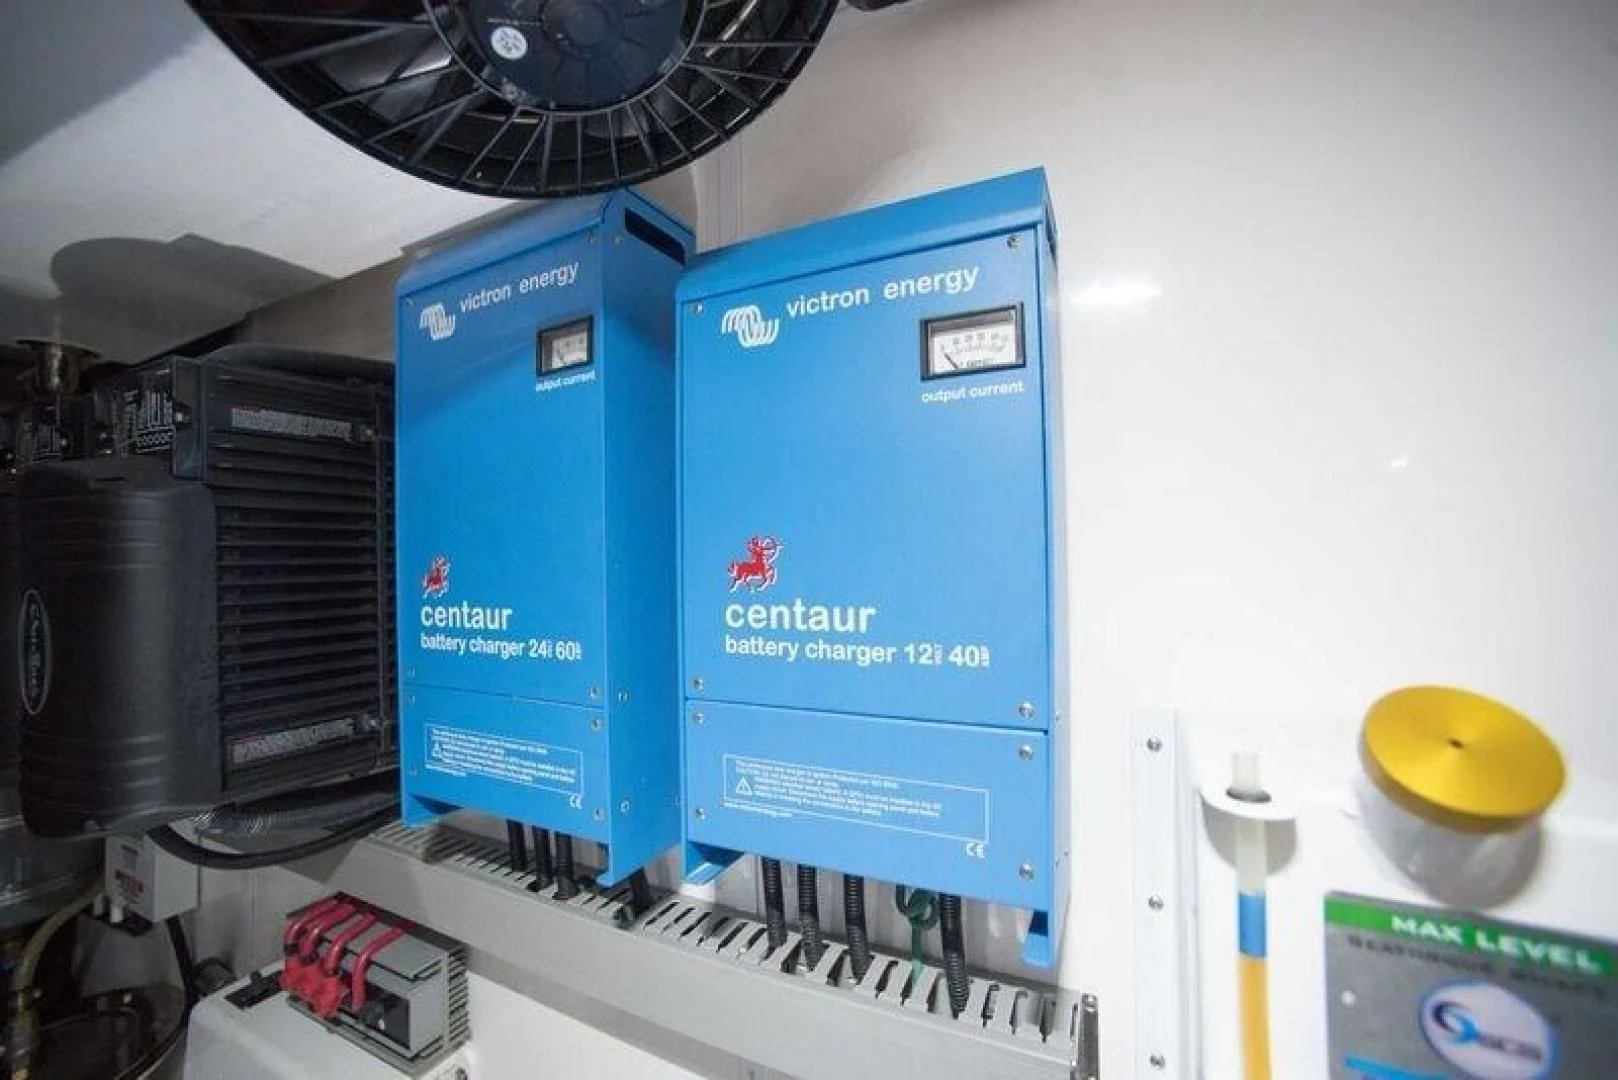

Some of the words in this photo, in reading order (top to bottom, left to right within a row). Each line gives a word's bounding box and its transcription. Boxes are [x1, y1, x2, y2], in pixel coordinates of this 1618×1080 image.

[460, 284, 511, 314] victron
[519, 261, 580, 295] energy
[786, 286, 870, 318] victron
[883, 265, 979, 301] energy
[921, 386, 966, 404] output
[970, 379, 1025, 398] current
[420, 600, 513, 631] centaur
[725, 598, 877, 634] centaur
[420, 632, 468, 656] battery
[469, 635, 525, 660] charger
[725, 634, 800, 662] battery
[804, 639, 897, 667] charger
[1390, 915, 1464, 946] MAX
[1475, 929, 1604, 975] LEVEL
